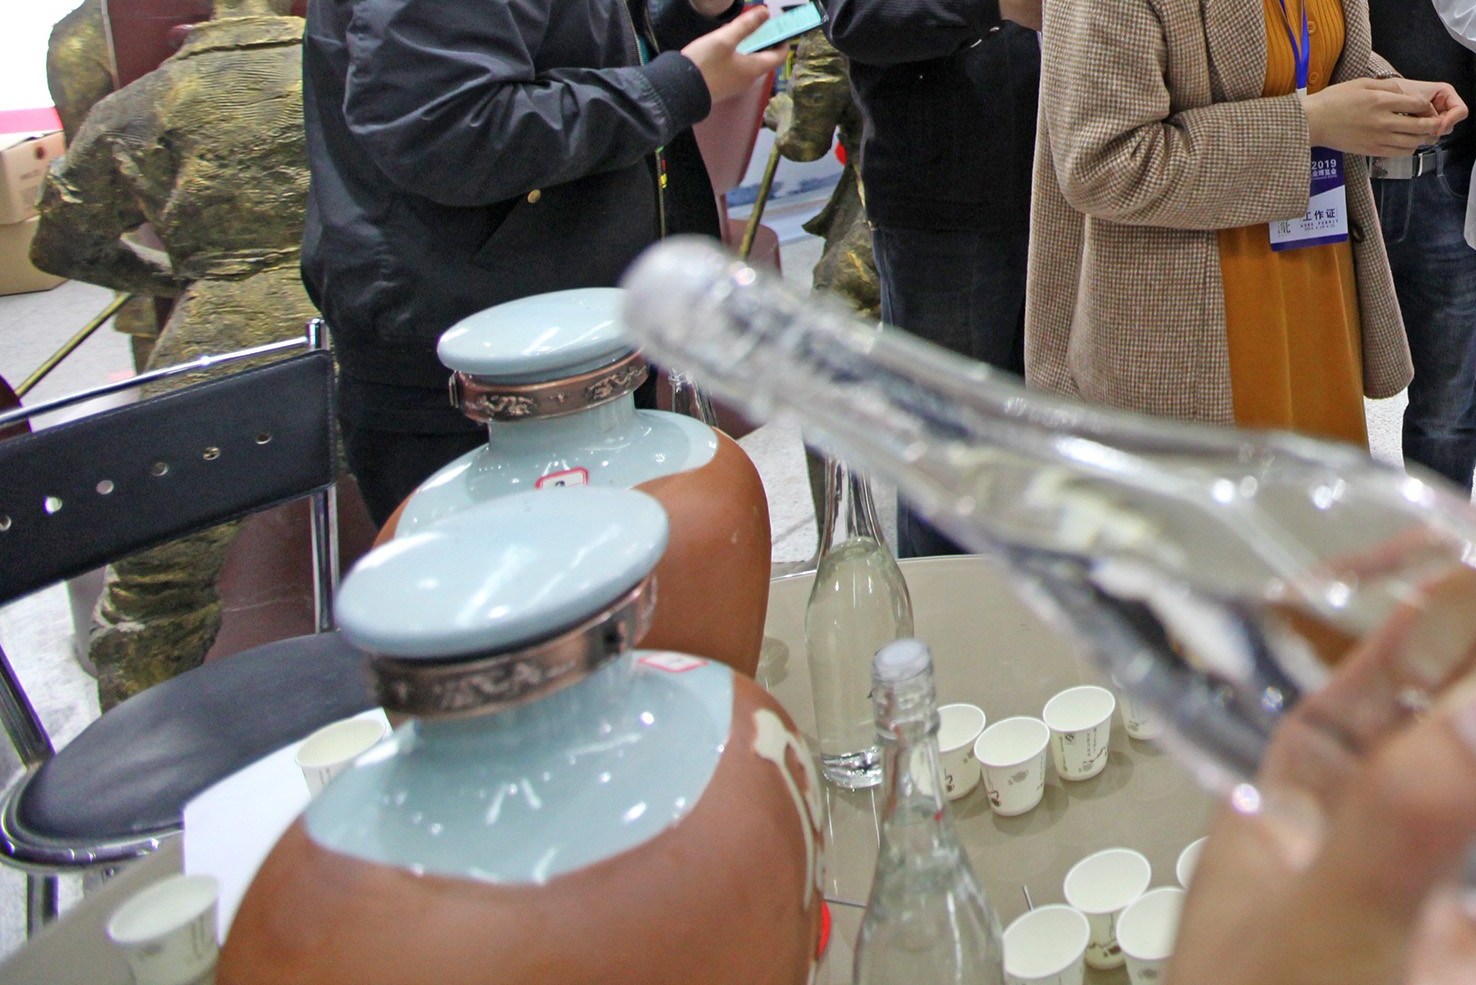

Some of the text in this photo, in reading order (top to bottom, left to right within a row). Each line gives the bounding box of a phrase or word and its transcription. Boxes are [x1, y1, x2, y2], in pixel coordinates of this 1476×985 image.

[1311, 159, 1337, 170] 2019
[1303, 208, 1336, 222] 工作证
